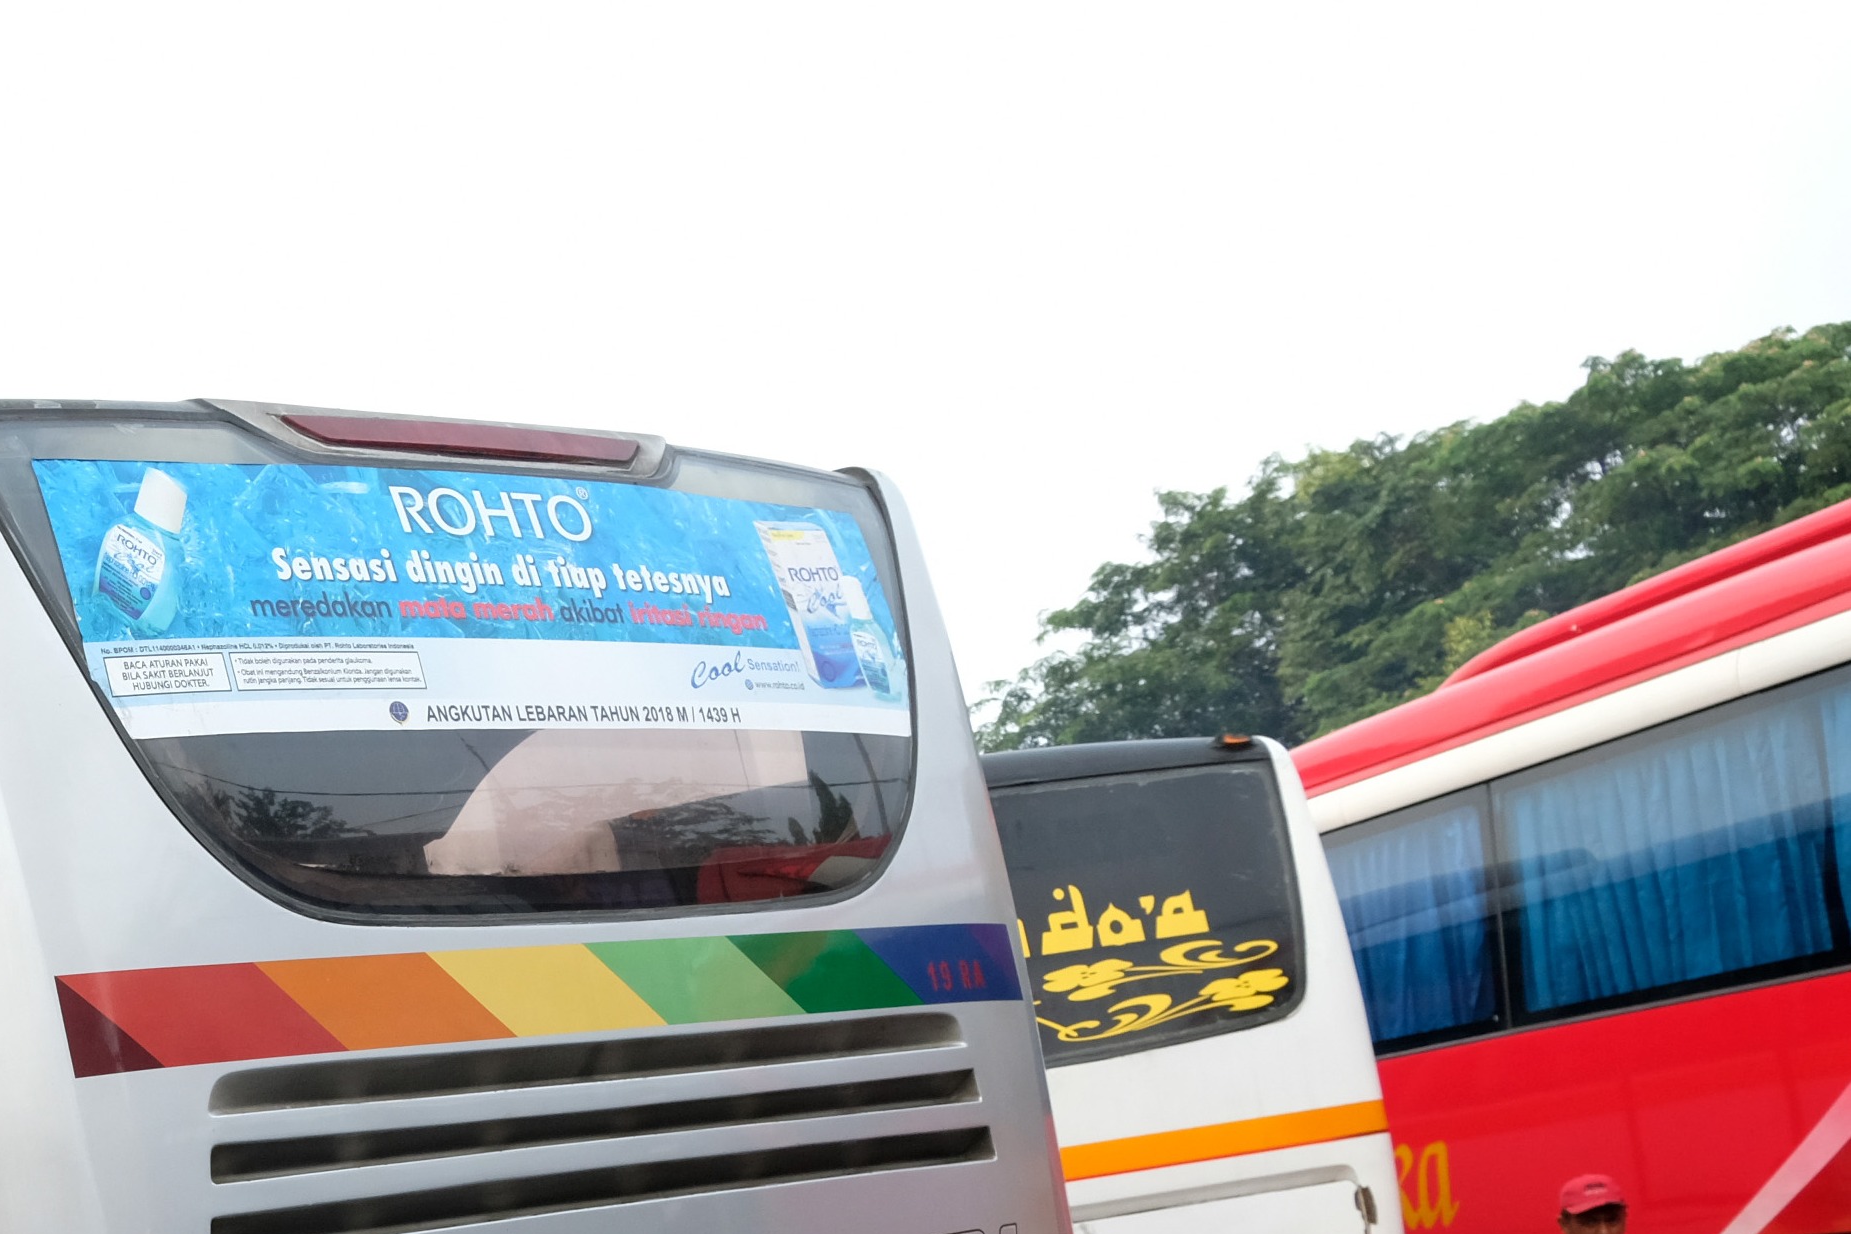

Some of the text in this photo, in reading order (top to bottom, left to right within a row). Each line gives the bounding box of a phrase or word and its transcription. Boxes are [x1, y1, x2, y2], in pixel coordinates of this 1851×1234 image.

[388, 485, 593, 541] ROHTO
[116, 533, 157, 566] ROHTO
[270, 547, 730, 604] Sensasi dingin di tiap tetesnya
[788, 567, 839, 582] ROHTO
[249, 590, 768, 634] meredakan mata merah akibat iritasi ringan
[122, 668, 214, 681] BILA SAKIT BERLANJUT
[123, 658, 208, 670] BACA ATURAN PAKAI
[691, 650, 801, 689] Cool Sensation!
[133, 679, 210, 691] HUBUNGI DOKTER.
[426, 704, 513, 723] ANGKUTAN
[516, 704, 587, 723] LEBARAN
[590, 705, 640, 723] TAHUN
[644, 706, 674, 723] 2018
[678, 706, 689, 723] M
[698, 706, 728, 724] 1439
[731, 707, 742, 724] H
